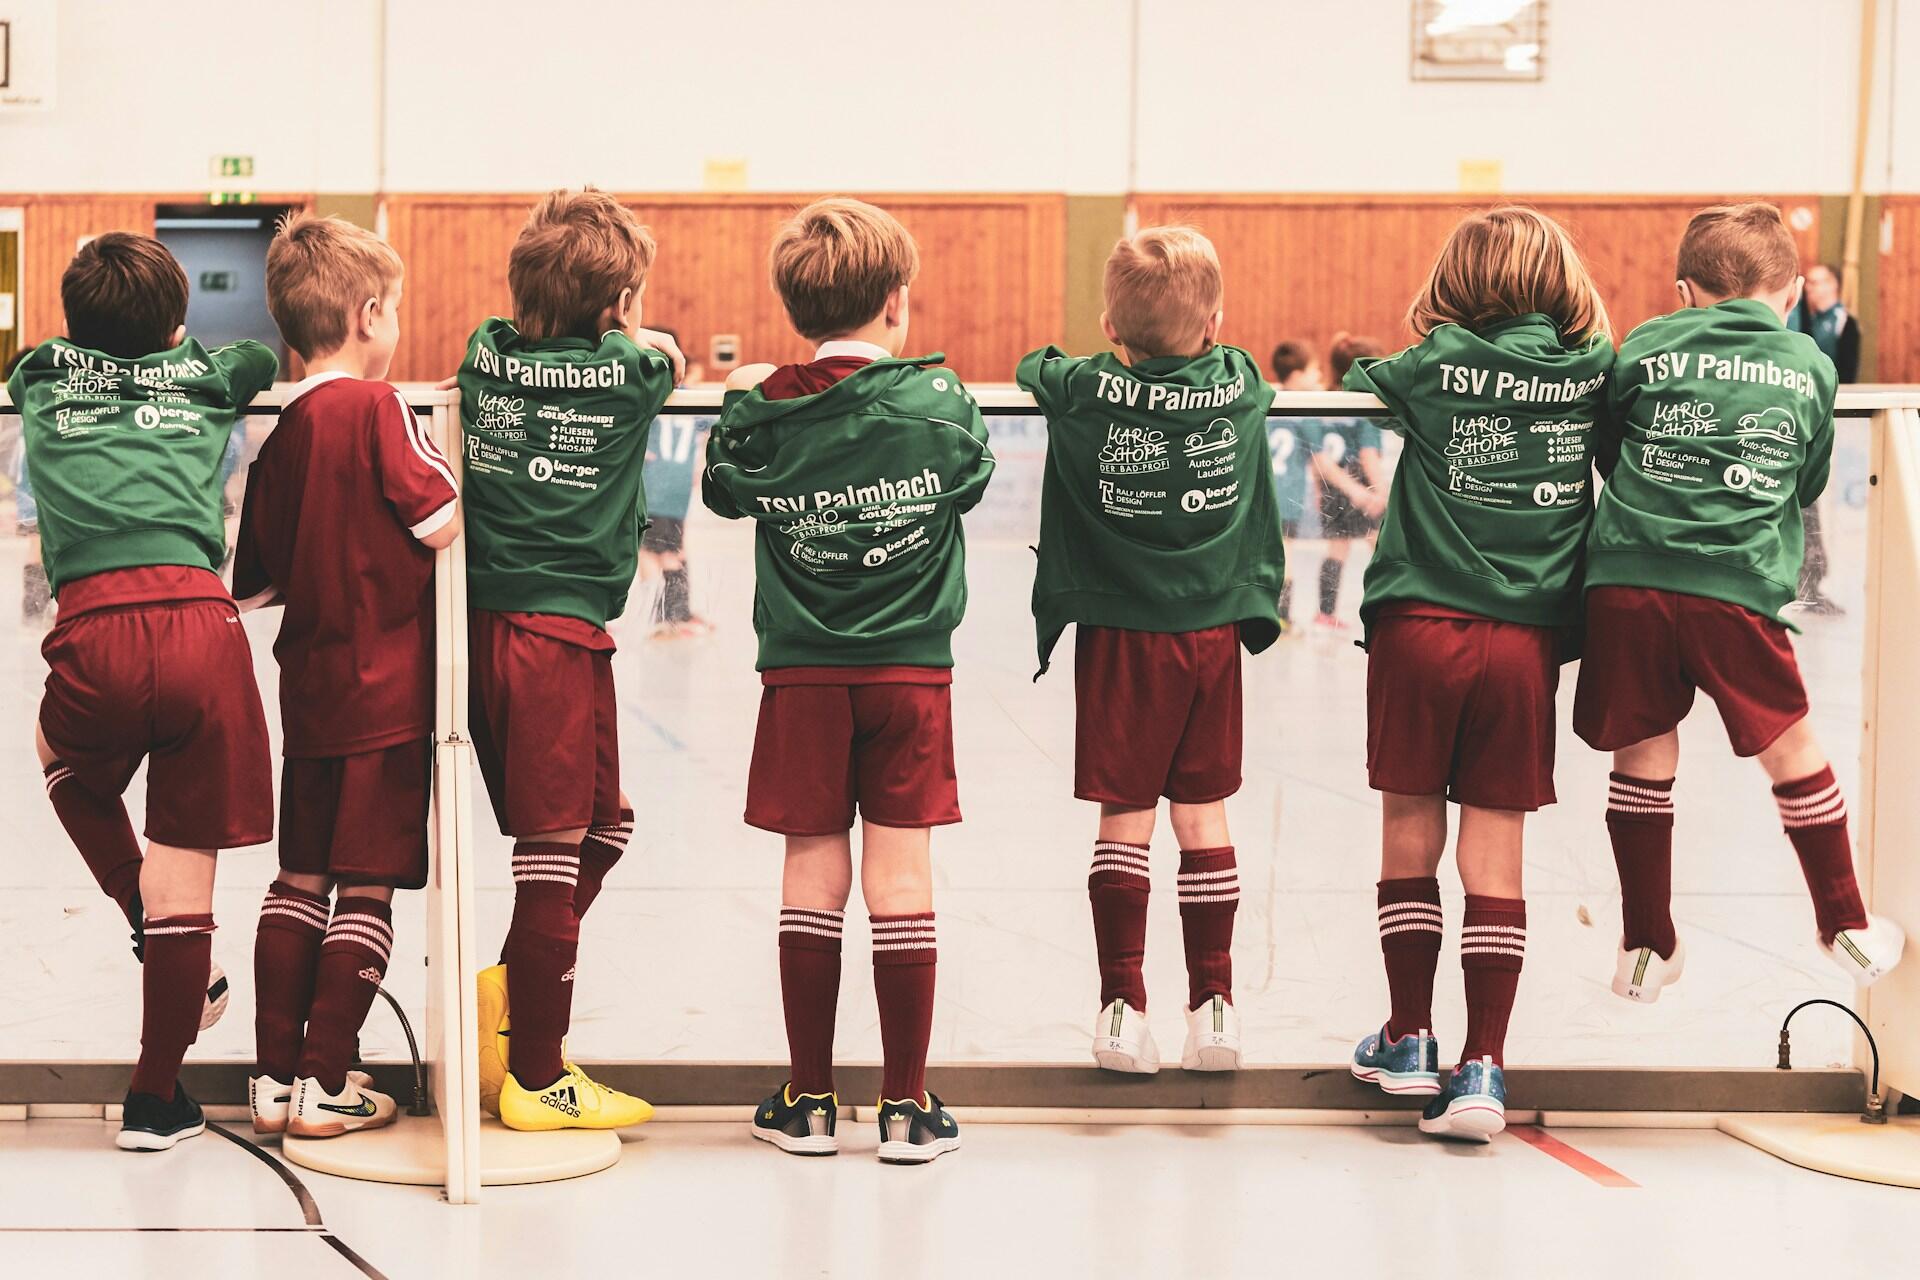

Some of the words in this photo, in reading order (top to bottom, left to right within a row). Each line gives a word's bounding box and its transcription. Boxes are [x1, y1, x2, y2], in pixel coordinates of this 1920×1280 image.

[506, 358, 626, 388] Palmbach
[1640, 352, 1689, 384] TSV
[1697, 353, 1815, 400] Palmbach
[1097, 370, 1141, 407] TSV
[1147, 370, 1245, 411] Palmbach
[1439, 364, 1489, 396] TSV
[1495, 371, 1606, 403] Palmbach
[71, 416, 97, 424] DESIGN
[160, 406, 202, 421] berger
[560, 426, 594, 436] FLIESEN
[559, 435, 598, 445] PLATTEN
[481, 450, 501, 461] DESIGN
[558, 444, 595, 453] MOSAIK
[1737, 437, 1790, 459] Auto-Service
[1188, 451, 1236, 469] Auto-Service
[1467, 450, 1519, 465] BAD-PROFI
[1656, 458, 1684, 469] DESIGN
[1658, 450, 1677, 459] RALF
[1678, 454, 1710, 466] LÖFFLER
[1741, 450, 1783, 467] Laudicina
[553, 460, 600, 477] berger
[1100, 465, 1115, 473] DER
[1120, 460, 1170, 473] BAD-PROFI
[551, 477, 597, 490] Rohrreinigung
[757, 495, 806, 513] TSV
[814, 468, 942, 509] Palmbach
[1465, 483, 1493, 493] DESIGN
[1116, 488, 1134, 497] RALF
[1136, 490, 1167, 498] LÖFFLER
[1116, 496, 1142, 506] DESIGN
[886, 526, 926, 552] berger
[801, 552, 825, 565] DESIGN
[818, 551, 849, 560] LÖFFLER
[540, 1095, 581, 1118] adidas
